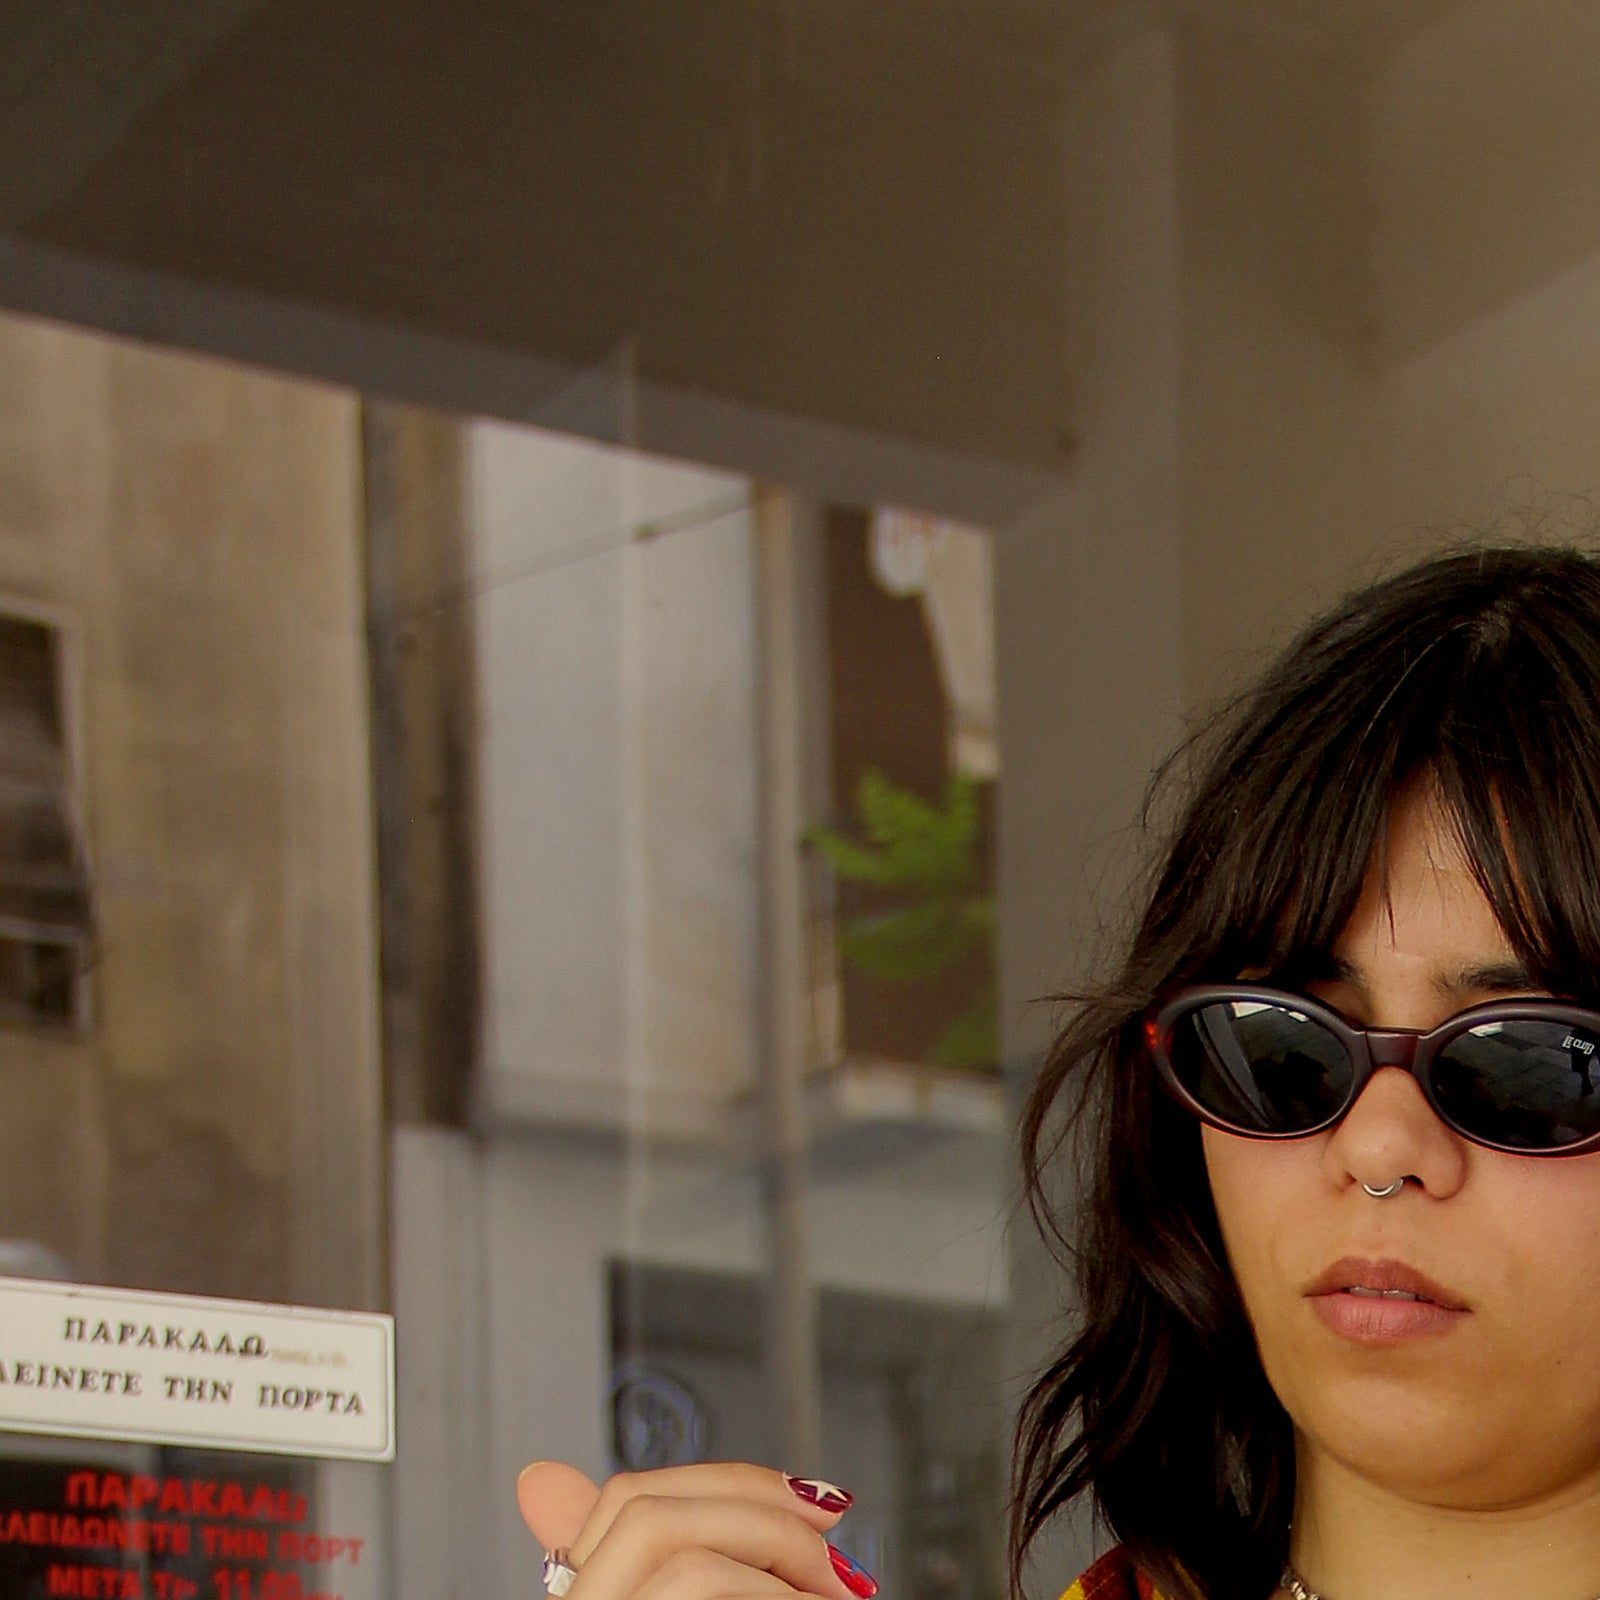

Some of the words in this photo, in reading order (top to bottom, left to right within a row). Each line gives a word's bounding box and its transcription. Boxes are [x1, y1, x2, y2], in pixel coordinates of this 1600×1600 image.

[64, 1316, 268, 1357] ΠΑΡΑΚΑΛΩ
[164, 1375, 235, 1403] ΤΗΝ
[258, 1383, 365, 1417] ΠΟΡΤΑ
[202, 1524, 268, 1560] ΤΗΝ
